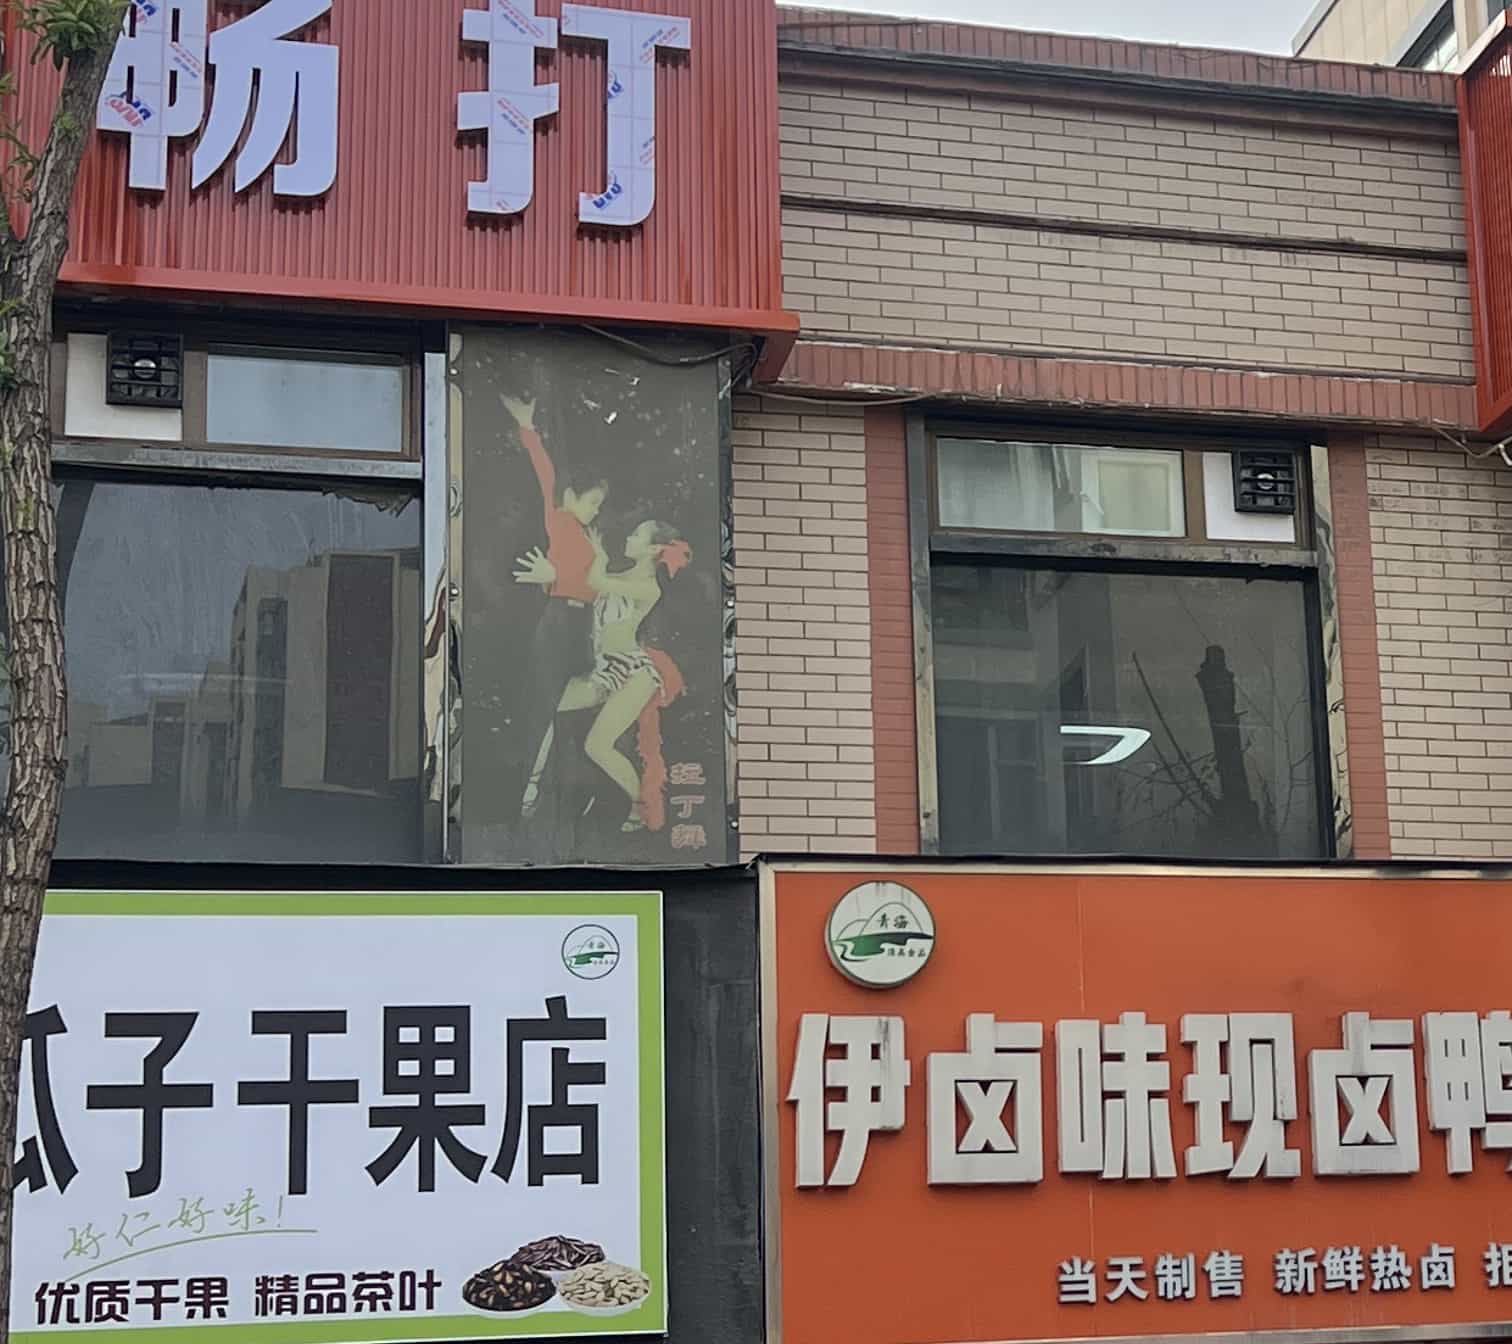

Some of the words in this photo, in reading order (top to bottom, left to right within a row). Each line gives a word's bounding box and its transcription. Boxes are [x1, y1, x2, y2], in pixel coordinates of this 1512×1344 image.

[35, 1276, 229, 1325] 优质干果
[255, 1269, 442, 1317] 精品茶叶
[1057, 1252, 1245, 1304] 当天制售
[1274, 1244, 1456, 1296] 新鲜热卤
